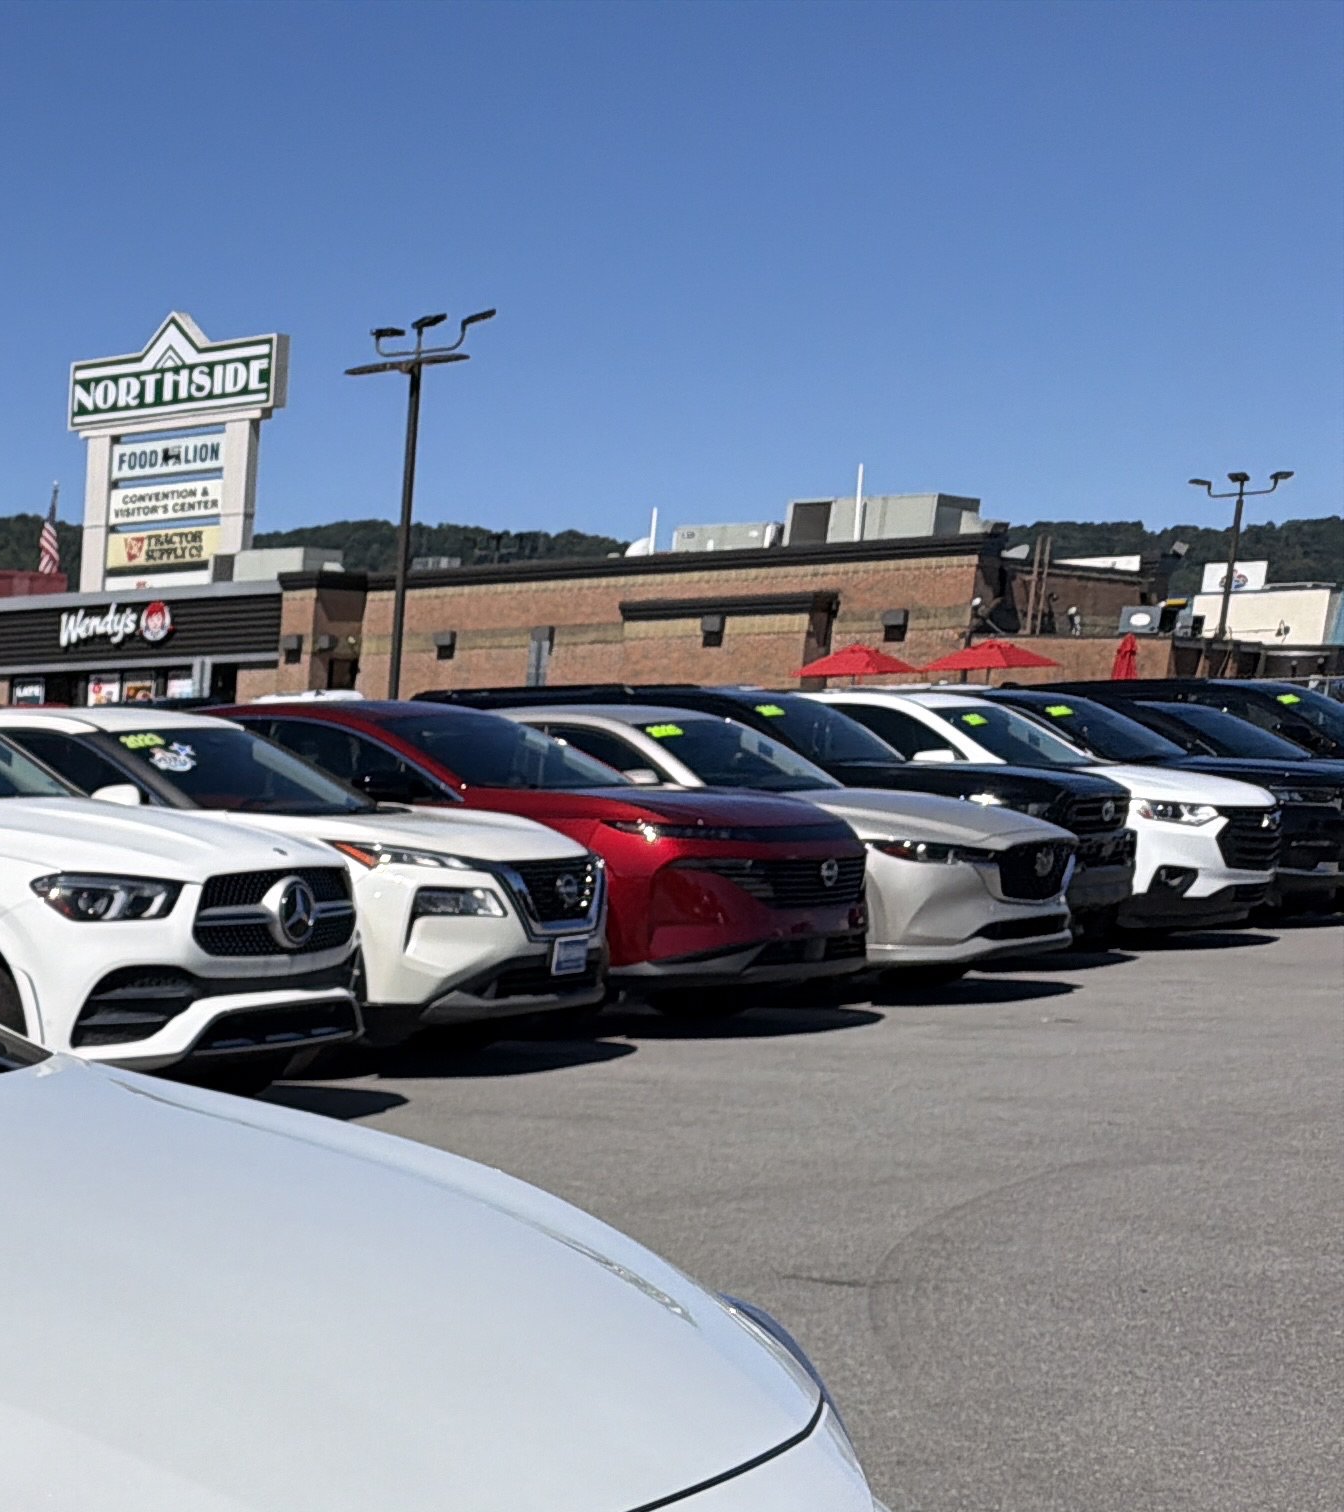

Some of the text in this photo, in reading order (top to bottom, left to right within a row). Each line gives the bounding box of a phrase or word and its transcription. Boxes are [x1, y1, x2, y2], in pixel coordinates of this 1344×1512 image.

[73, 357, 269, 413] NORTHSIDE
[118, 442, 221, 472] FOOD LION
[122, 487, 197, 505] CONVENTION
[114, 499, 219, 518] VISITOR'S CENTER
[146, 530, 204, 547] TRACTOR
[59, 601, 138, 648] Wendy's
